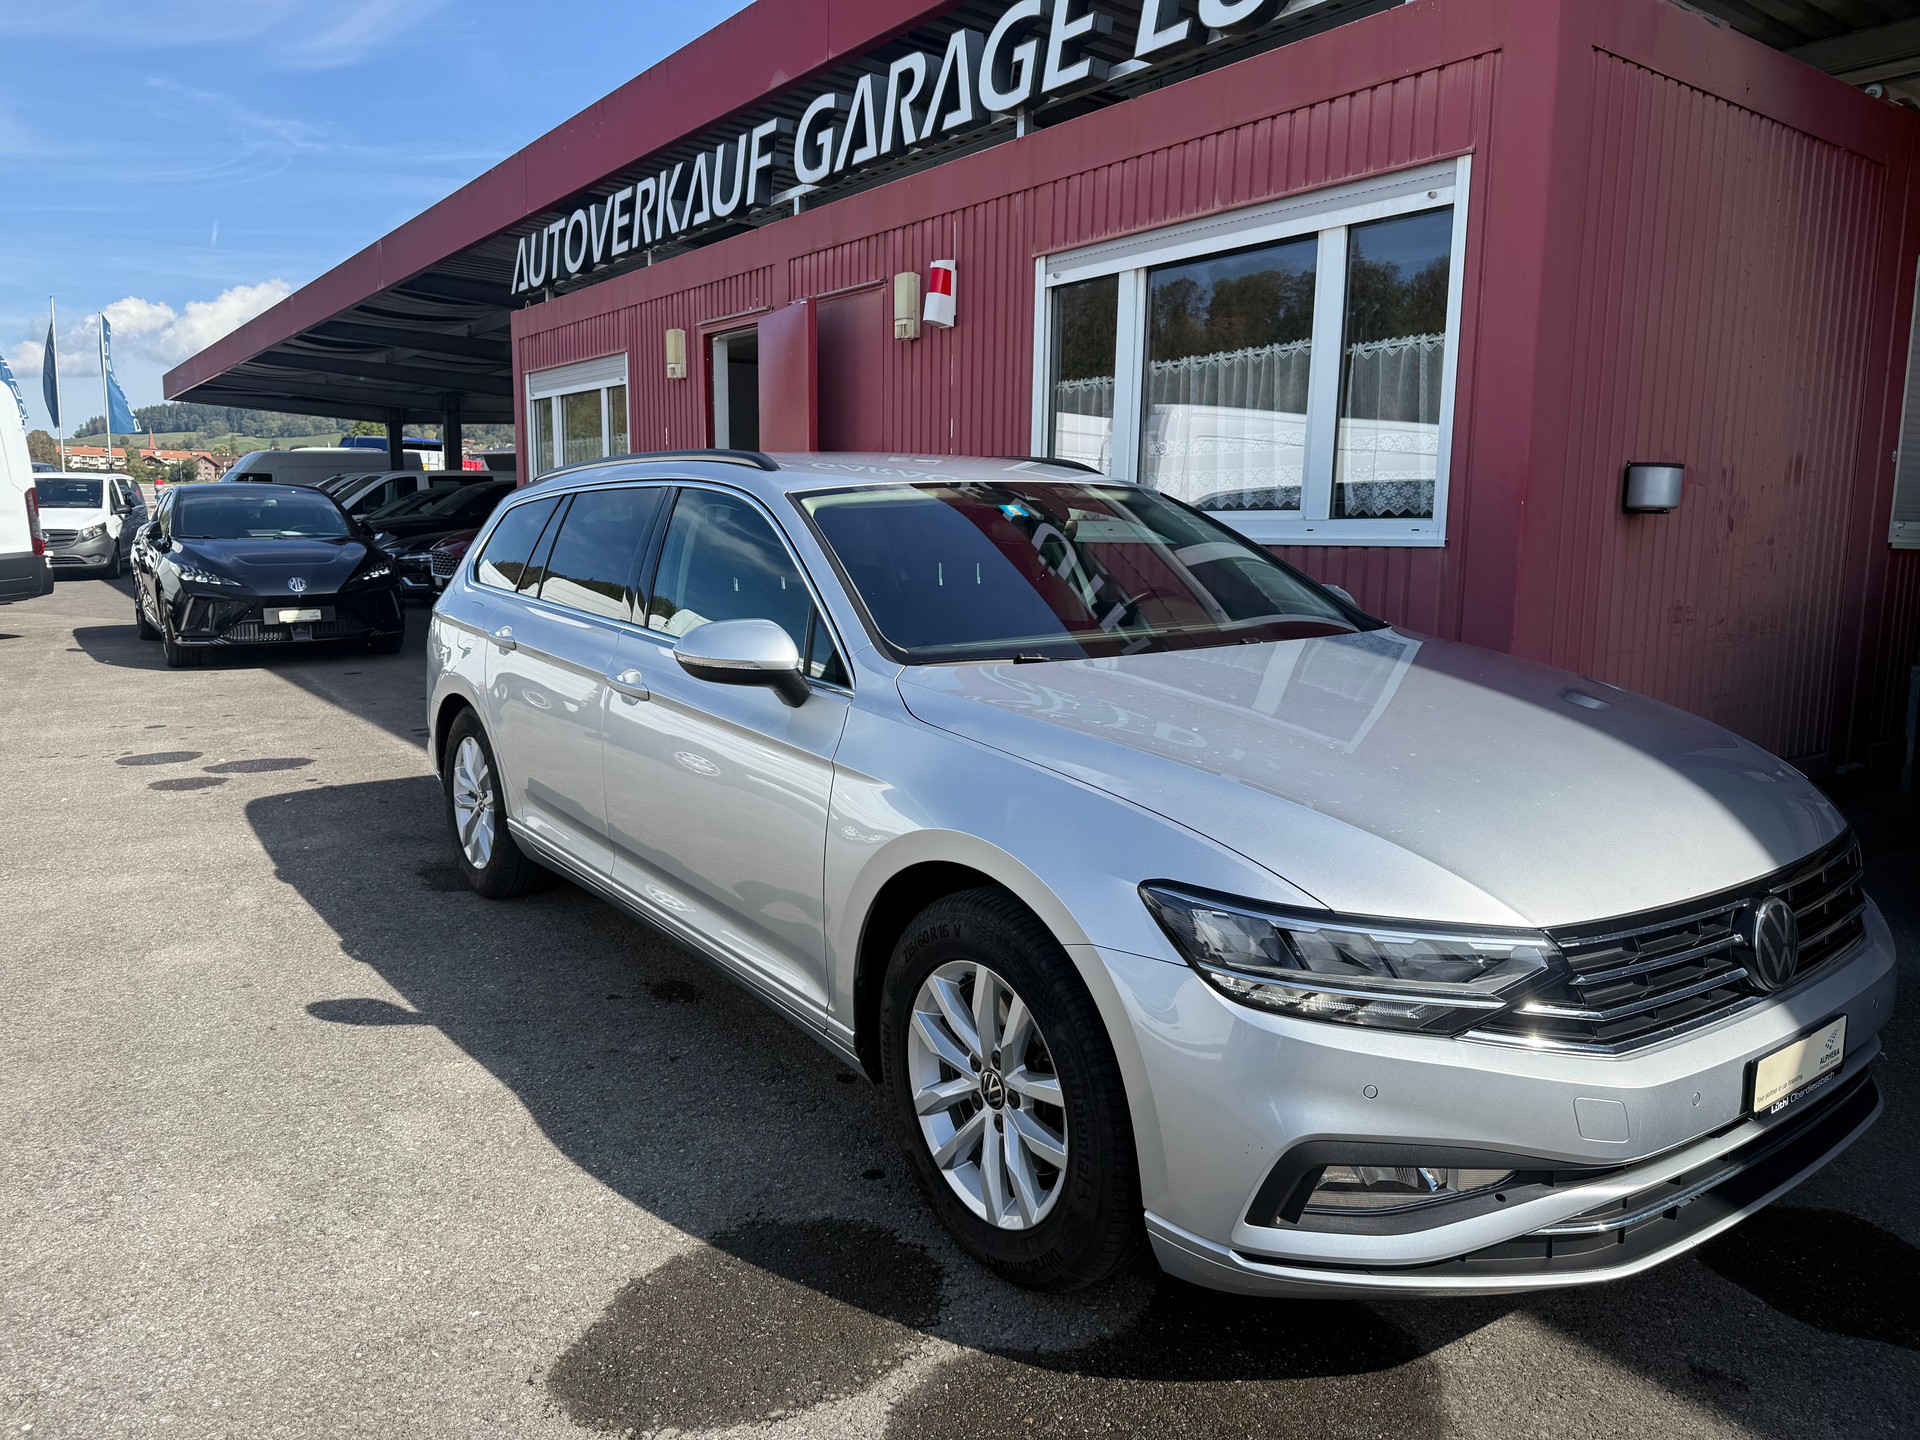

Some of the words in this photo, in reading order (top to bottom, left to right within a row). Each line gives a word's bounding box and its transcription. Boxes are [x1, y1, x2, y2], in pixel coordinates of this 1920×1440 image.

[511, 117, 778, 295] AUTOVERKAUF
[794, 0, 1096, 184] GARAGE
[902, 930, 930, 963] 215/60
[953, 923, 962, 938] V
[1820, 1047, 1840, 1066] ALPHERA
[1790, 1071, 1835, 1103] Oberdiessbach
